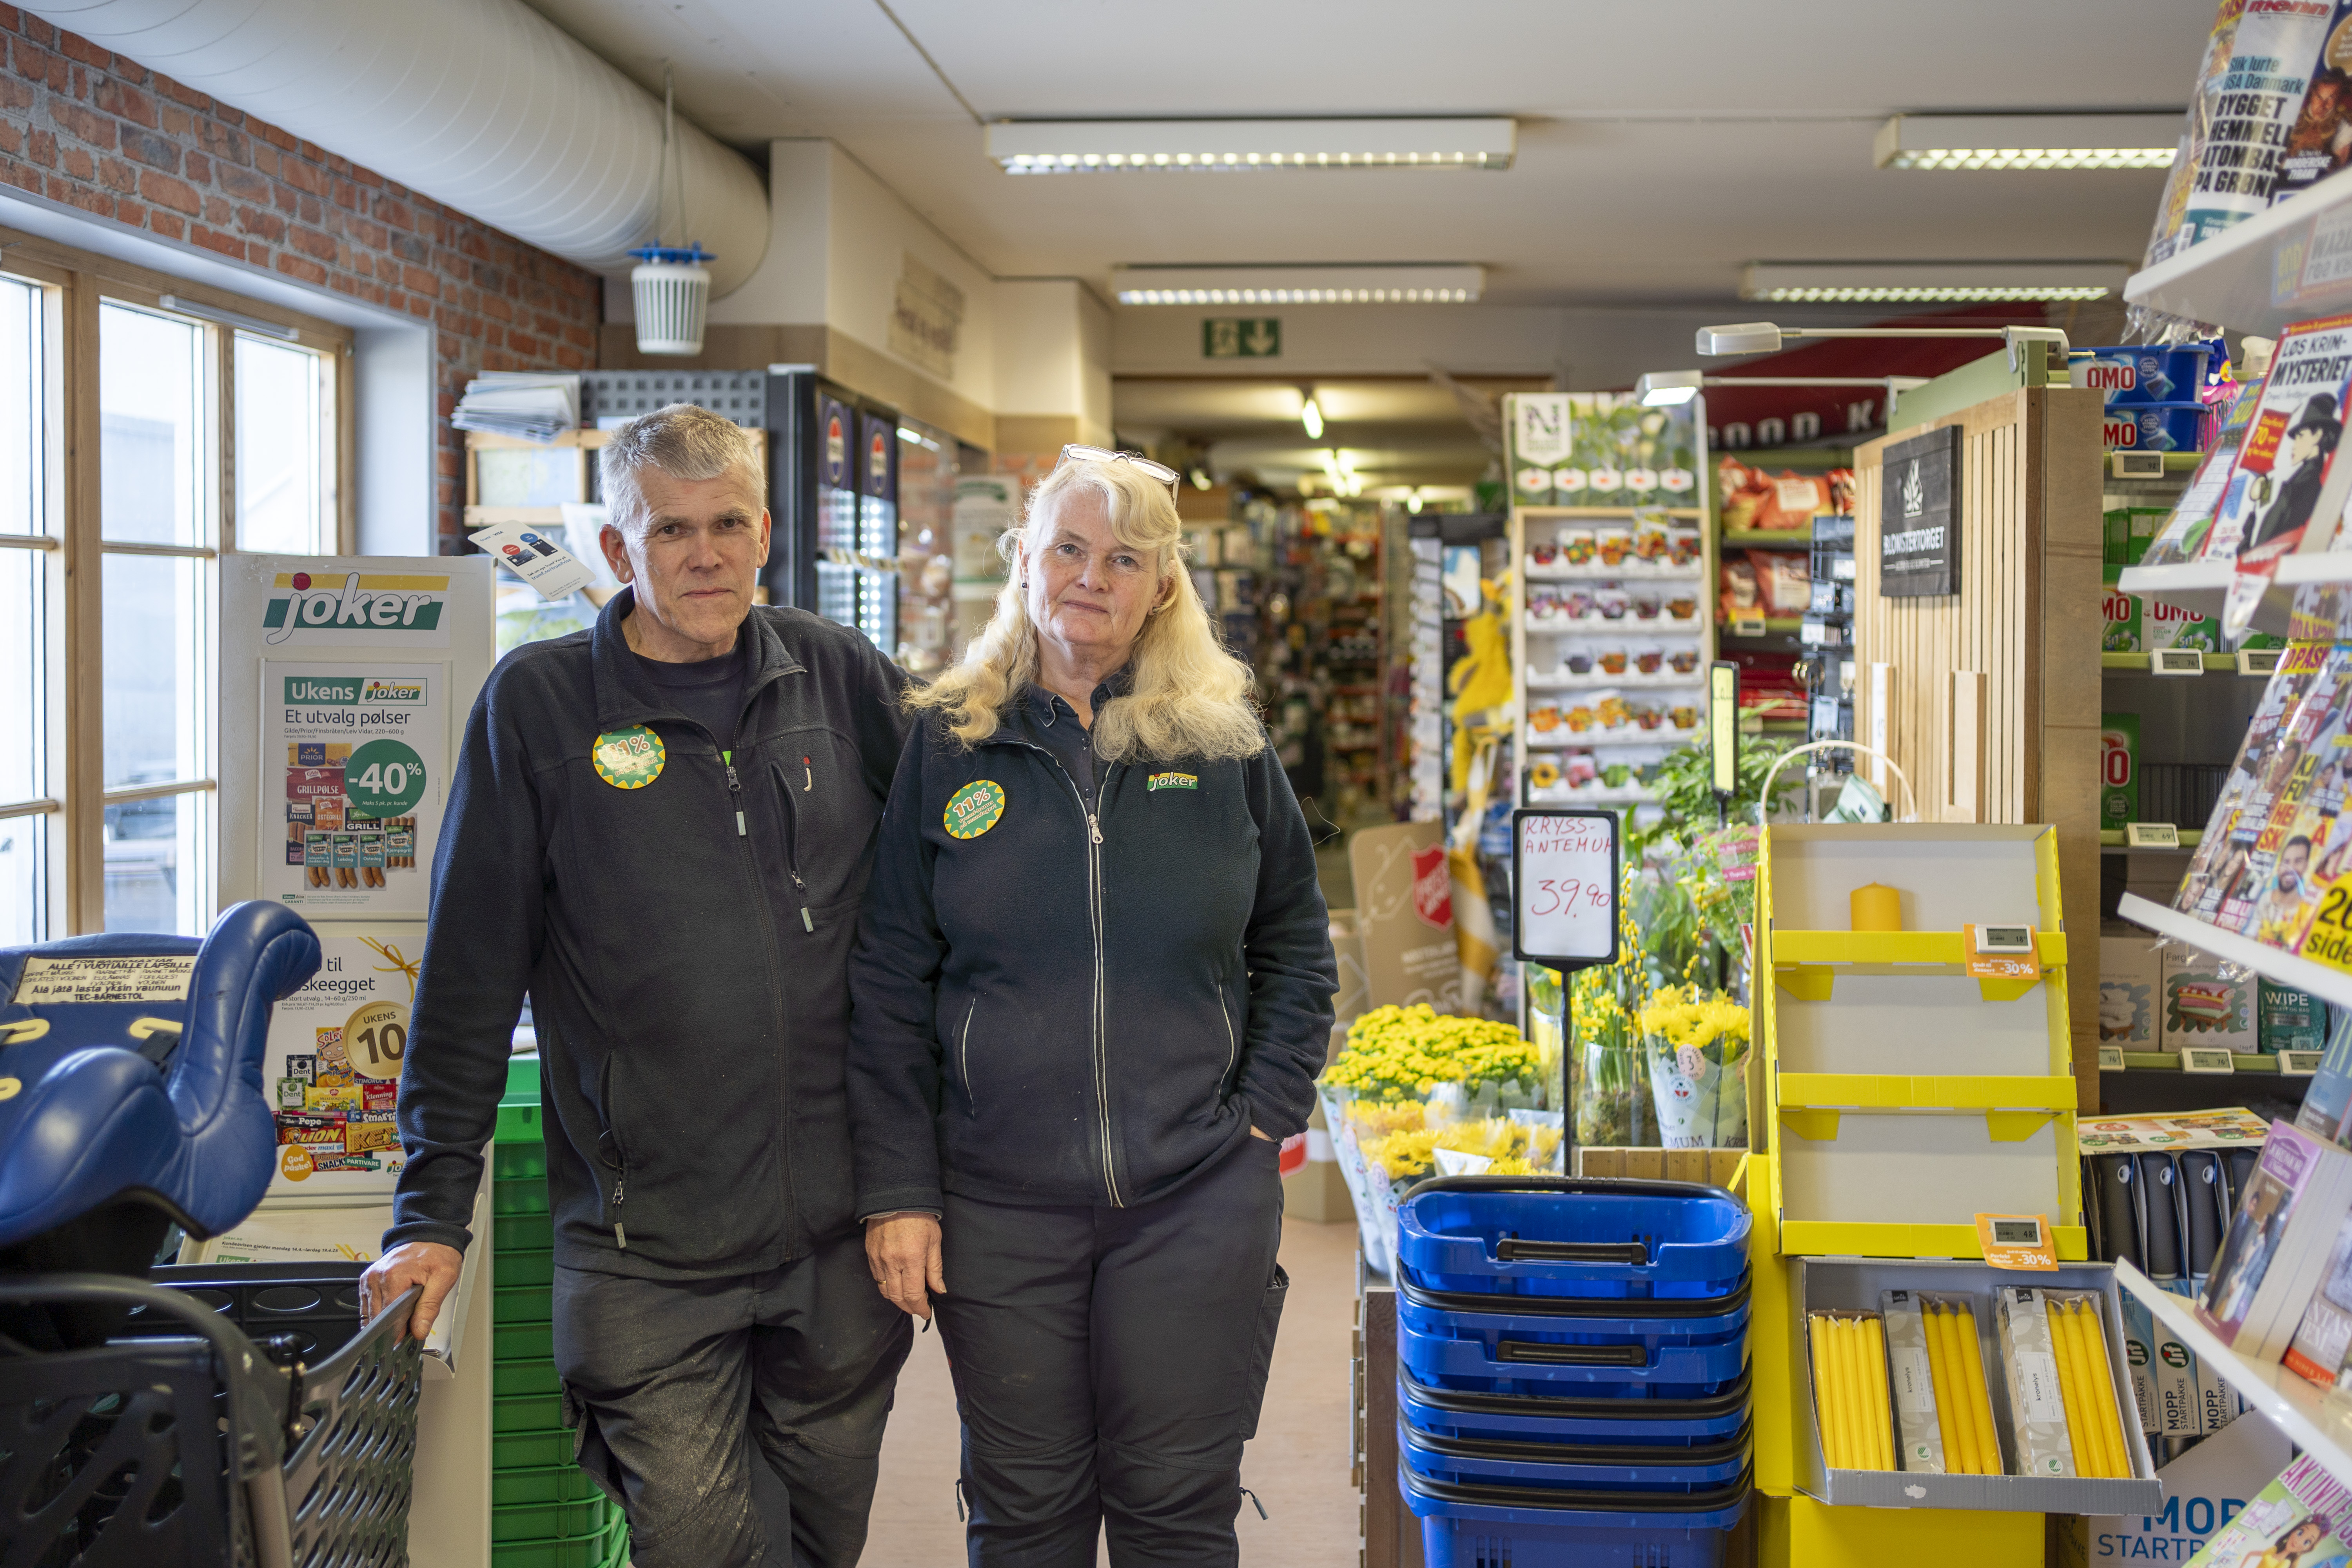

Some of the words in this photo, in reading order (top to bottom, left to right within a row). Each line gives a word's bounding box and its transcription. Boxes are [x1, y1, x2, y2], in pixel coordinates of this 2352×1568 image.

[2216, 93, 2288, 119] BYGGET
[2087, 366, 2135, 390] OMO
[1883, 526, 1944, 556] BLOMSTERTORGET
[267, 572, 432, 645] joker
[292, 682, 354, 700] Ukens
[367, 681, 417, 702] joker
[285, 710, 303, 724] Et
[307, 710, 355, 726] utvalg
[361, 710, 411, 726] pølser
[606, 734, 650, 761] 11%
[349, 762, 422, 795] -40%
[1149, 771, 1196, 791] joker
[297, 785, 339, 794] GRILLPØLSE
[953, 788, 991, 818] 11%
[958, 800, 994, 824] Trumf-bonus
[960, 822, 967, 830] på
[967, 803, 997, 825] mandager!
[1525, 816, 1596, 835] KRYSS-
[327, 956, 342, 972] til
[2000, 963, 2033, 974] -30%
[105, 984, 132, 993] yksin
[2265, 991, 2309, 1007] WIPE
[363, 1011, 396, 1024] UKENS
[357, 1023, 407, 1064] 10
[298, 1117, 322, 1127] Pepe
[300, 1128, 342, 1143] LION
[284, 1161, 312, 1172] påske!
[287, 1154, 304, 1164] God
[347, 1158, 379, 1167] PARTIVARE
[2018, 1254, 2051, 1265] -30%
[2017, 1292, 2033, 1301] unik
[2163, 1344, 2187, 1367] Jif
[1903, 1366, 1913, 1394] kronelys
[2032, 1372, 2042, 1402] kronelys
[2165, 1390, 2180, 1430] MOPP
[2177, 1377, 2189, 1430] STARTPAKKE
[2206, 1389, 2221, 1430] MOPP
